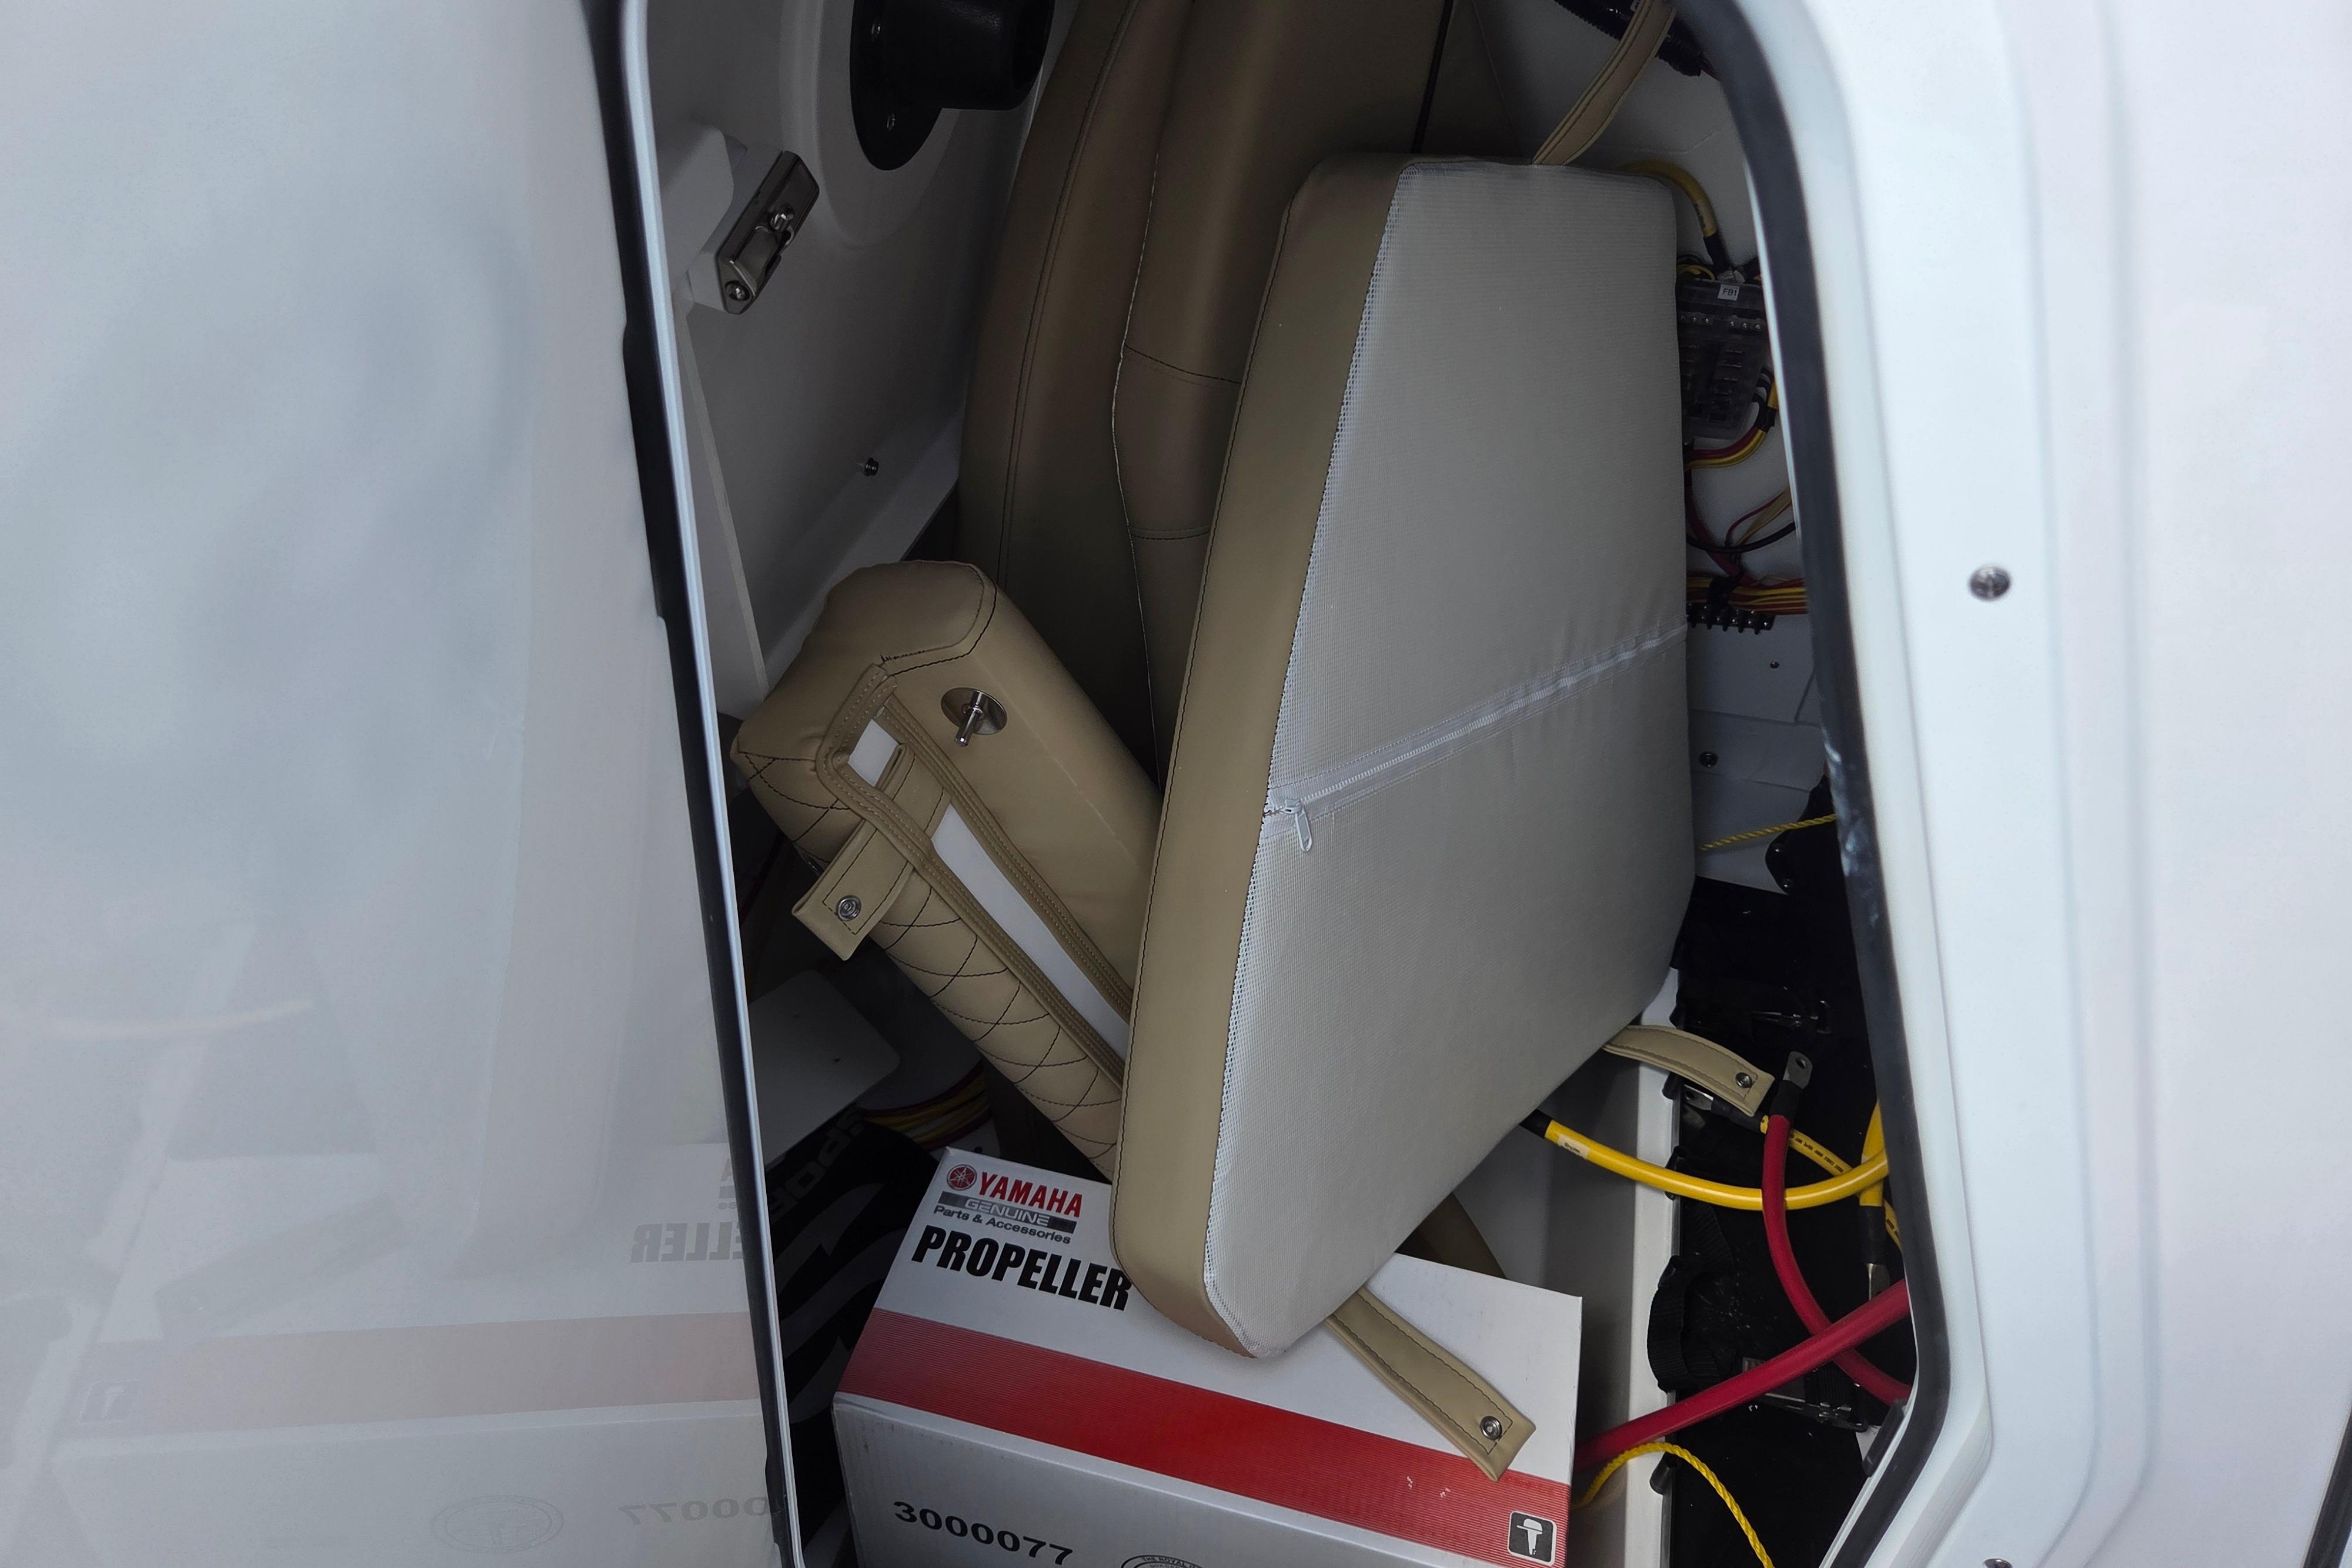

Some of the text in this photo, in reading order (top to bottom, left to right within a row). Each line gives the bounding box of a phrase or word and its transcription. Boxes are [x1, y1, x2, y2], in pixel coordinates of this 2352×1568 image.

[965, 1198, 1050, 1226] GENUINE
[978, 1172, 1083, 1218] YAMAHA
[933, 1205, 1071, 1244] Parts & Accessories
[911, 1225, 1132, 1311] PROPELLER
[893, 1501, 1073, 1566] 3000077
